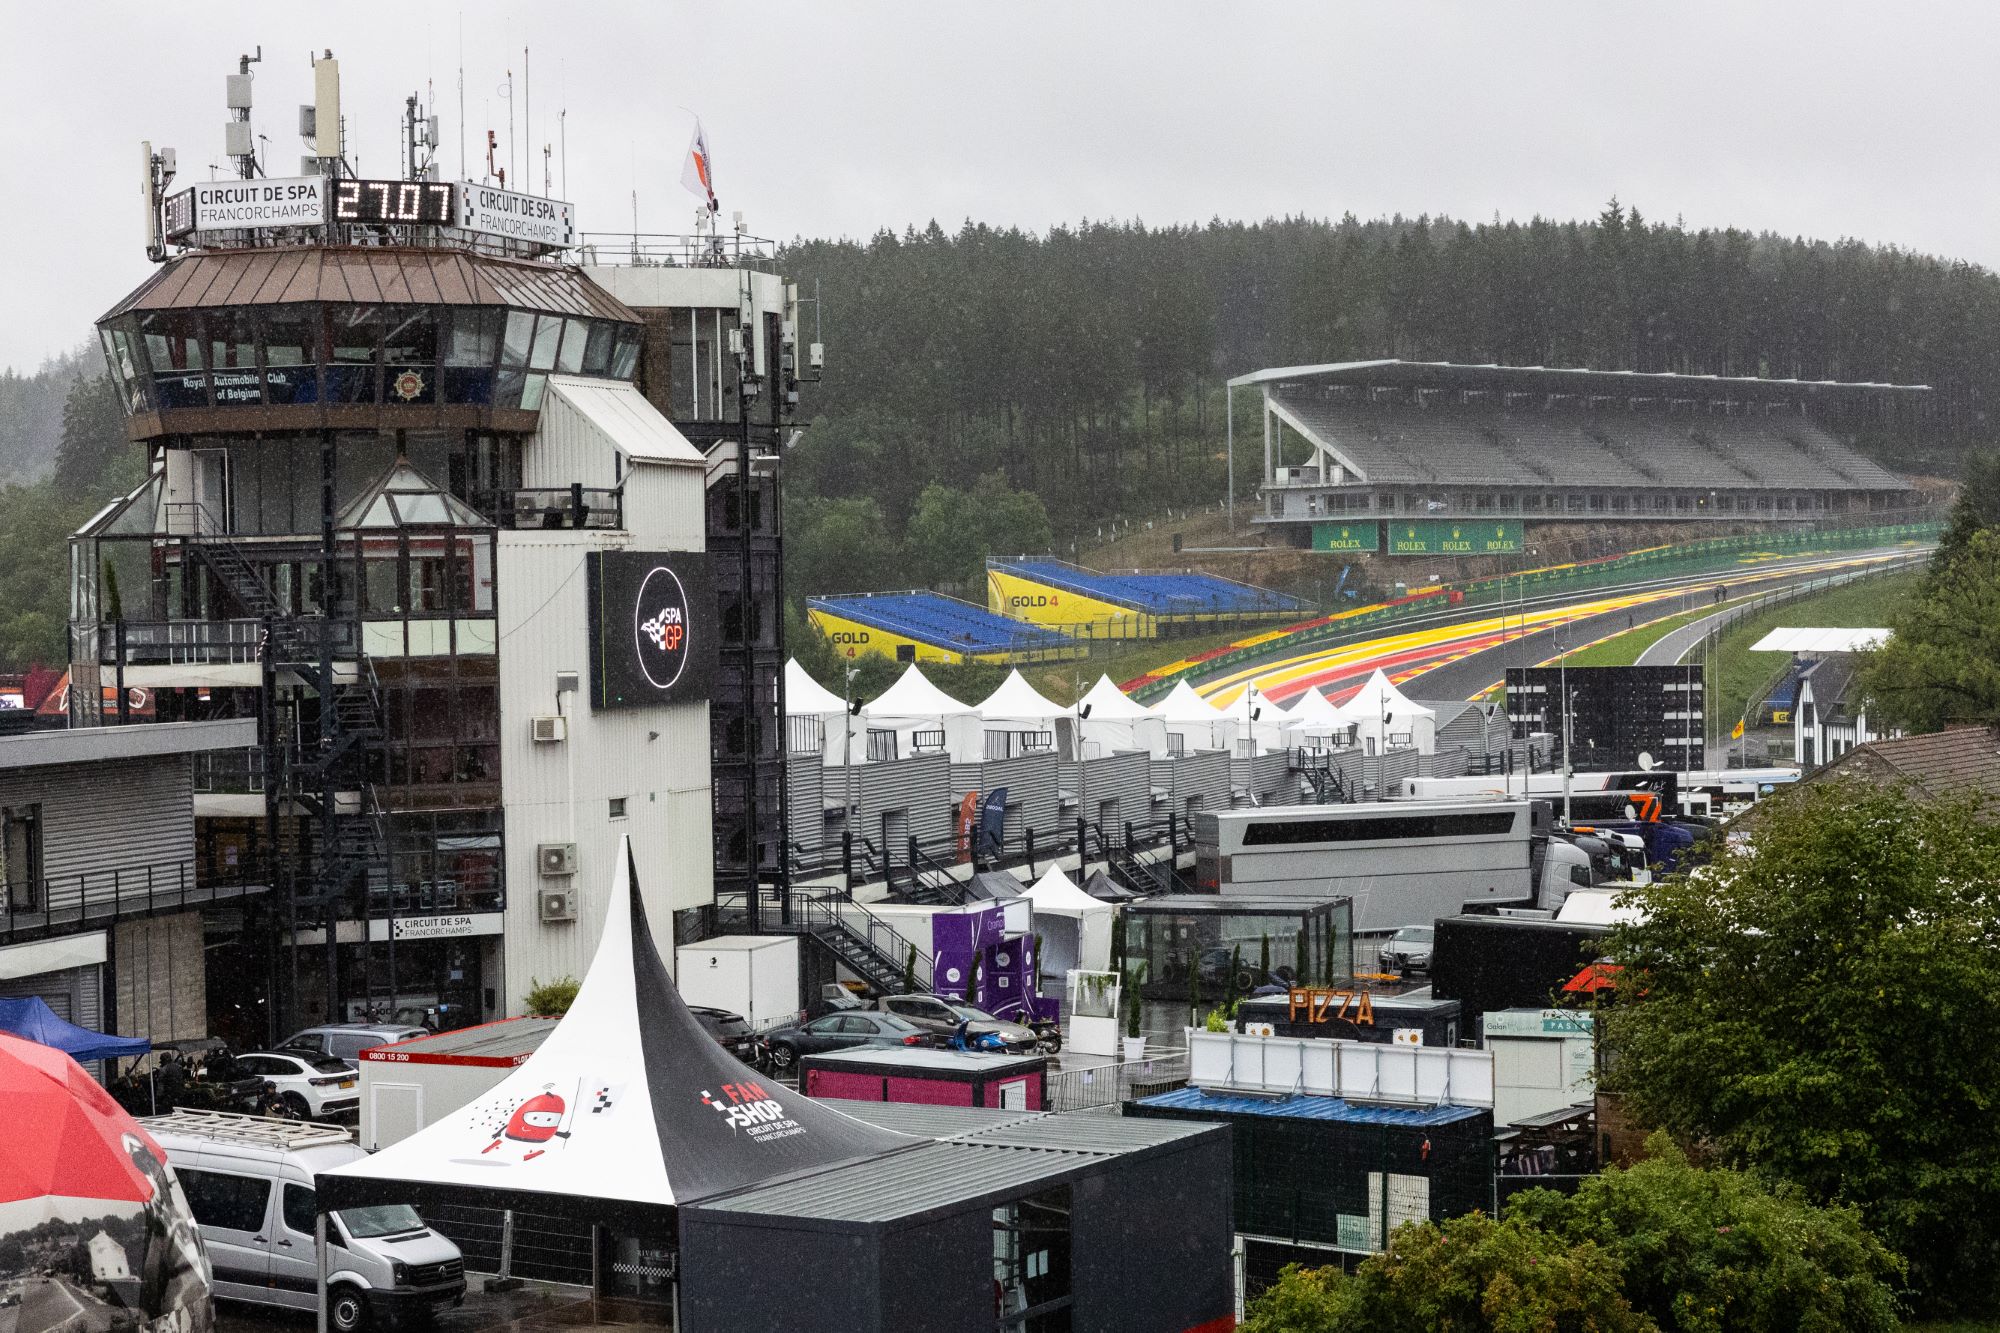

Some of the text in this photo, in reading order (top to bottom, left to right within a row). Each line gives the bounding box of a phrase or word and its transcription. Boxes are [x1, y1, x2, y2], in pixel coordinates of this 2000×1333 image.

[200, 184, 317, 205] CIRCUIT DE SPA
[338, 182, 450, 220] 27.07
[201, 203, 319, 222] FRANCORCHAMPS
[480, 190, 556, 221] CIRCUIT DE SPA
[480, 213, 557, 242] FRANCORCHAMPS
[183, 372, 286, 390] Royal Automobile Club
[217, 388, 261, 401] of Belgium
[1330, 540, 1361, 549] ROLEX
[1397, 541, 1426, 551] ROLEX
[1443, 541, 1471, 551] ROLEX
[1487, 540, 1514, 550] ROLEX
[1011, 595, 1058, 607] GOLD 4
[665, 607, 682, 624] SPA
[666, 626, 683, 650] GP
[832, 632, 869, 644] GOLD
[846, 647, 855, 658] 4
[404, 917, 471, 929] CIRCUIT DE SPA
[404, 926, 473, 937] FRANCORCHAMPS
[1289, 987, 1374, 1025] PIZZA
[1551, 1021, 1587, 1031] PASTA
[369, 1052, 409, 1062] 0800 15 200
[720, 1081, 770, 1104] FAN
[726, 1099, 785, 1127] SHOP
[746, 1119, 800, 1136] CIRCUIT DE SPA
[753, 1126, 807, 1143] FRANCORCHAMPS
